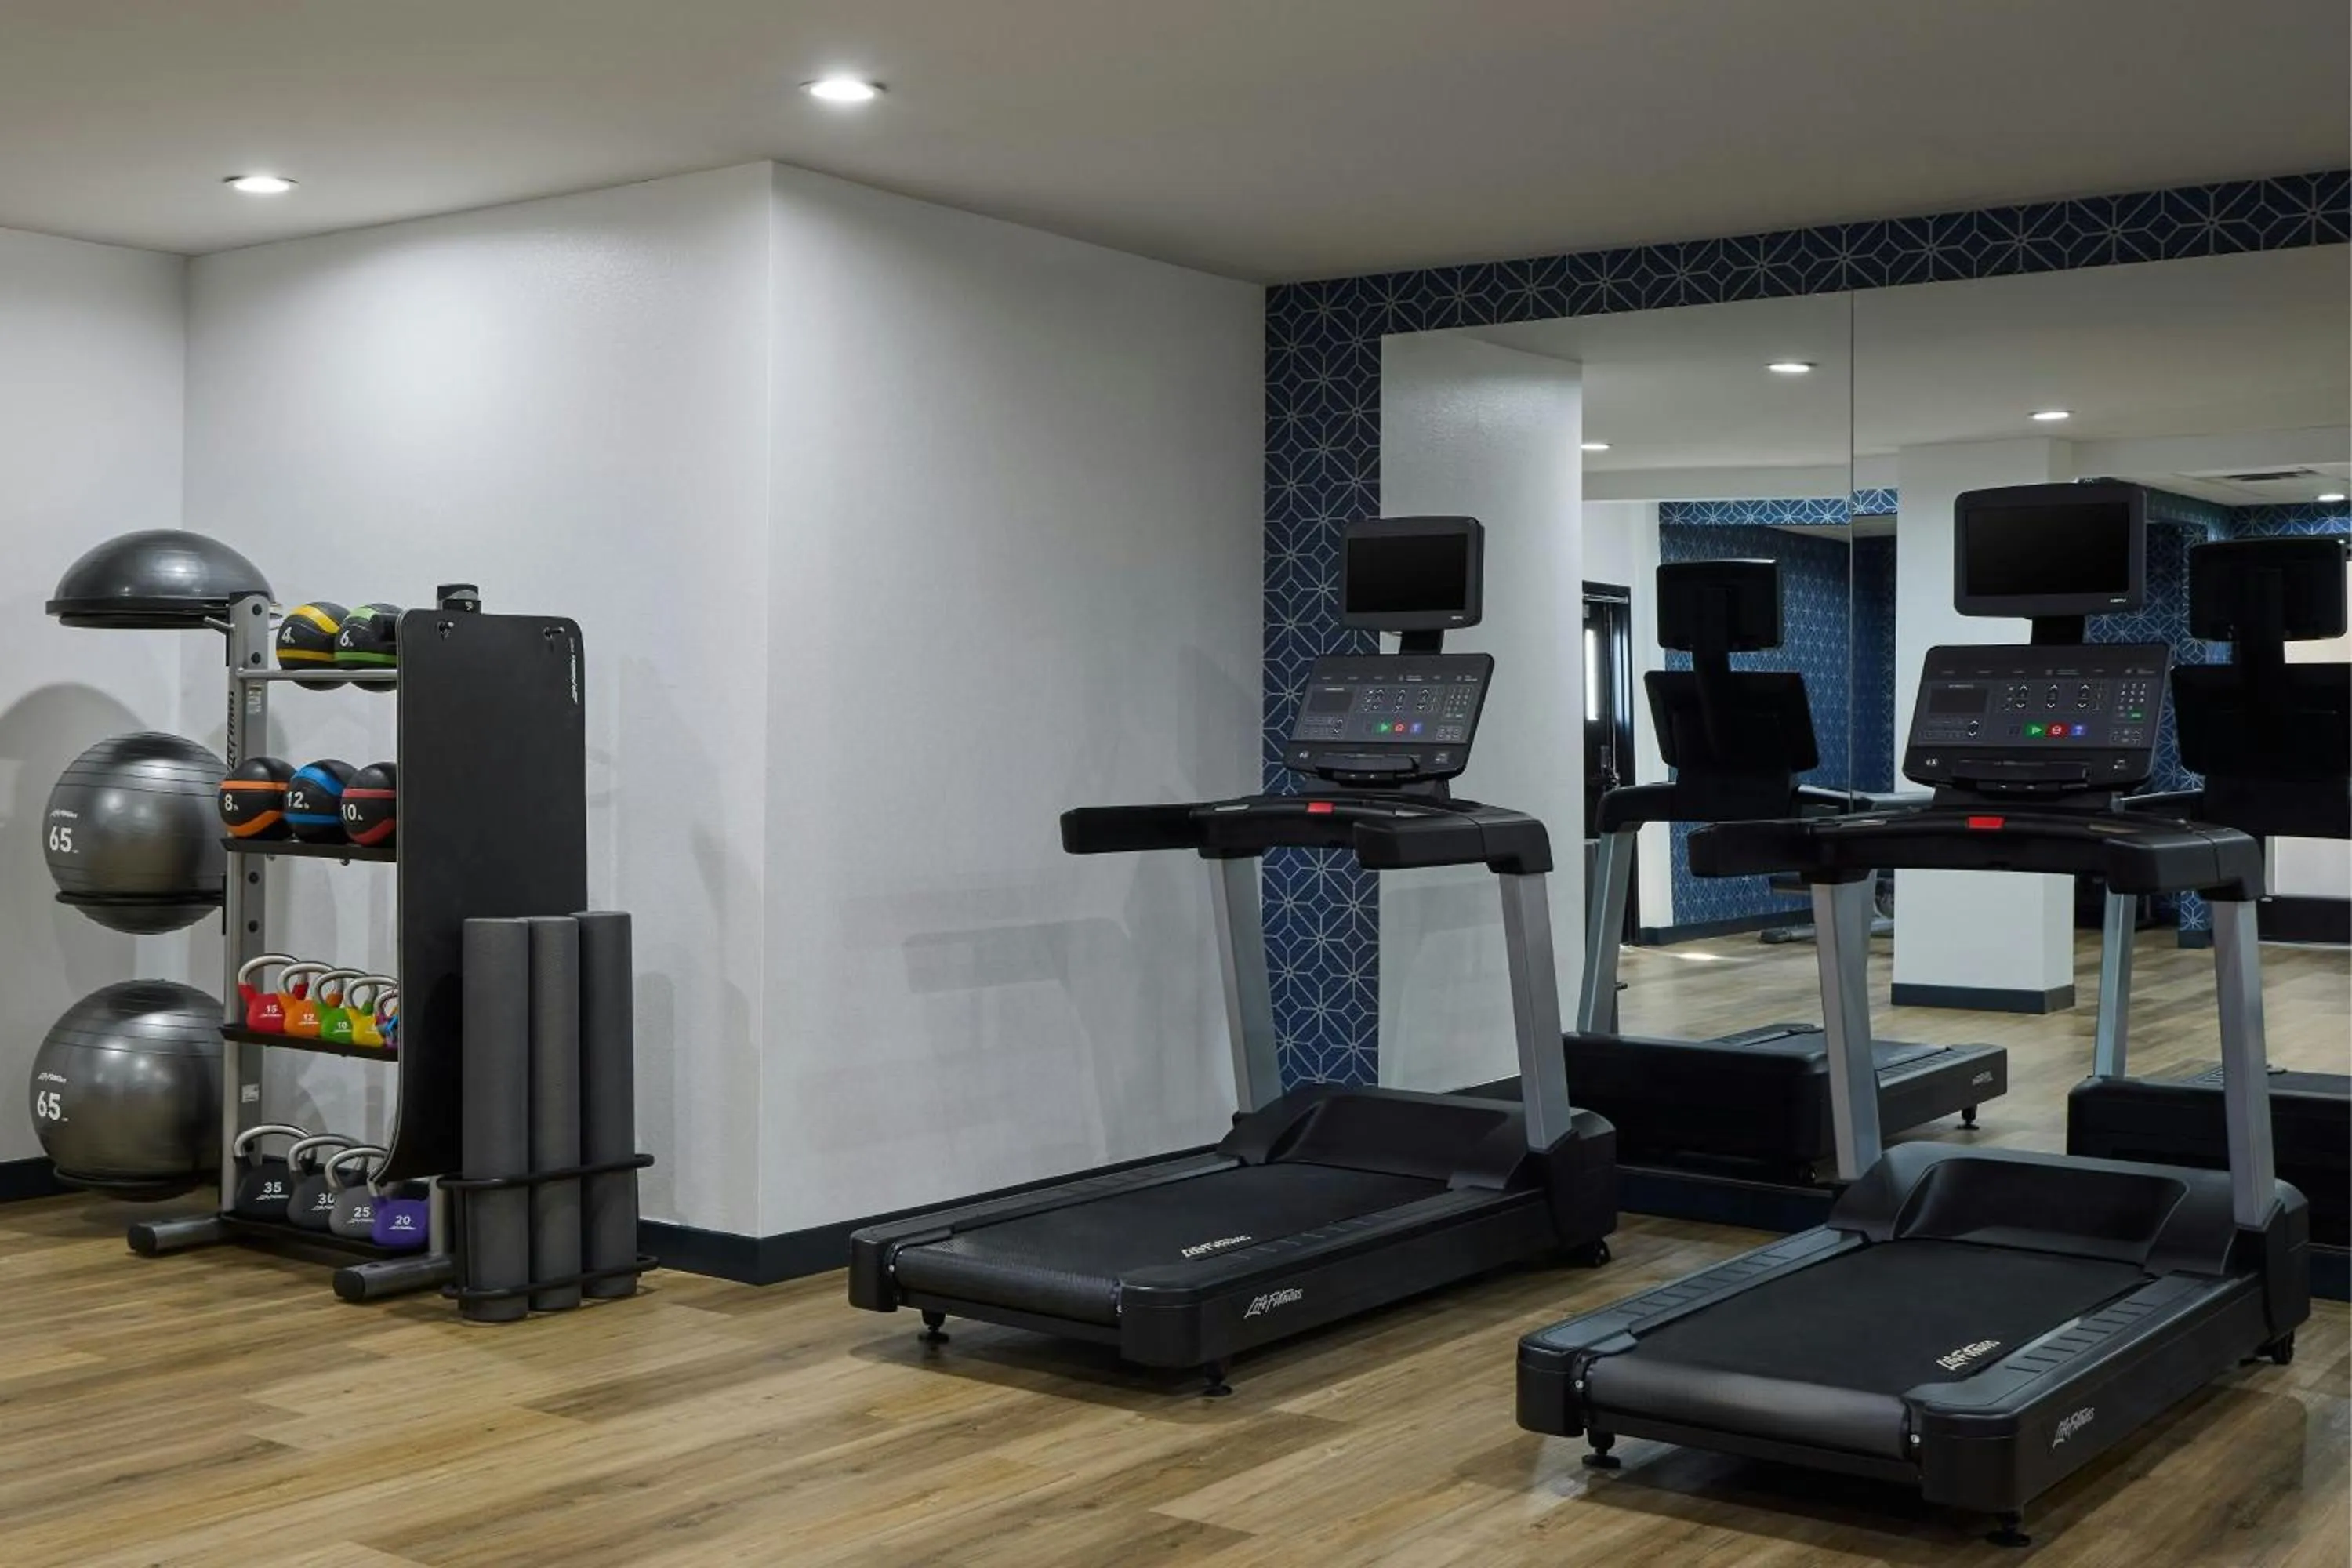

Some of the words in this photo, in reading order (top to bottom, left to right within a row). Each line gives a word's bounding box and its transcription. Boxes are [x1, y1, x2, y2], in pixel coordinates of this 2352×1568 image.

[281, 626, 292, 644] 4
[339, 630, 350, 647] 6
[224, 793, 233, 811] 8
[286, 791, 304, 808] 12
[341, 804, 358, 821] 10
[49, 826, 72, 853] 65
[37, 1091, 61, 1120] 65
[263, 1181, 282, 1193] 35
[354, 1207, 371, 1218] 25
[395, 1214, 412, 1225] 20
